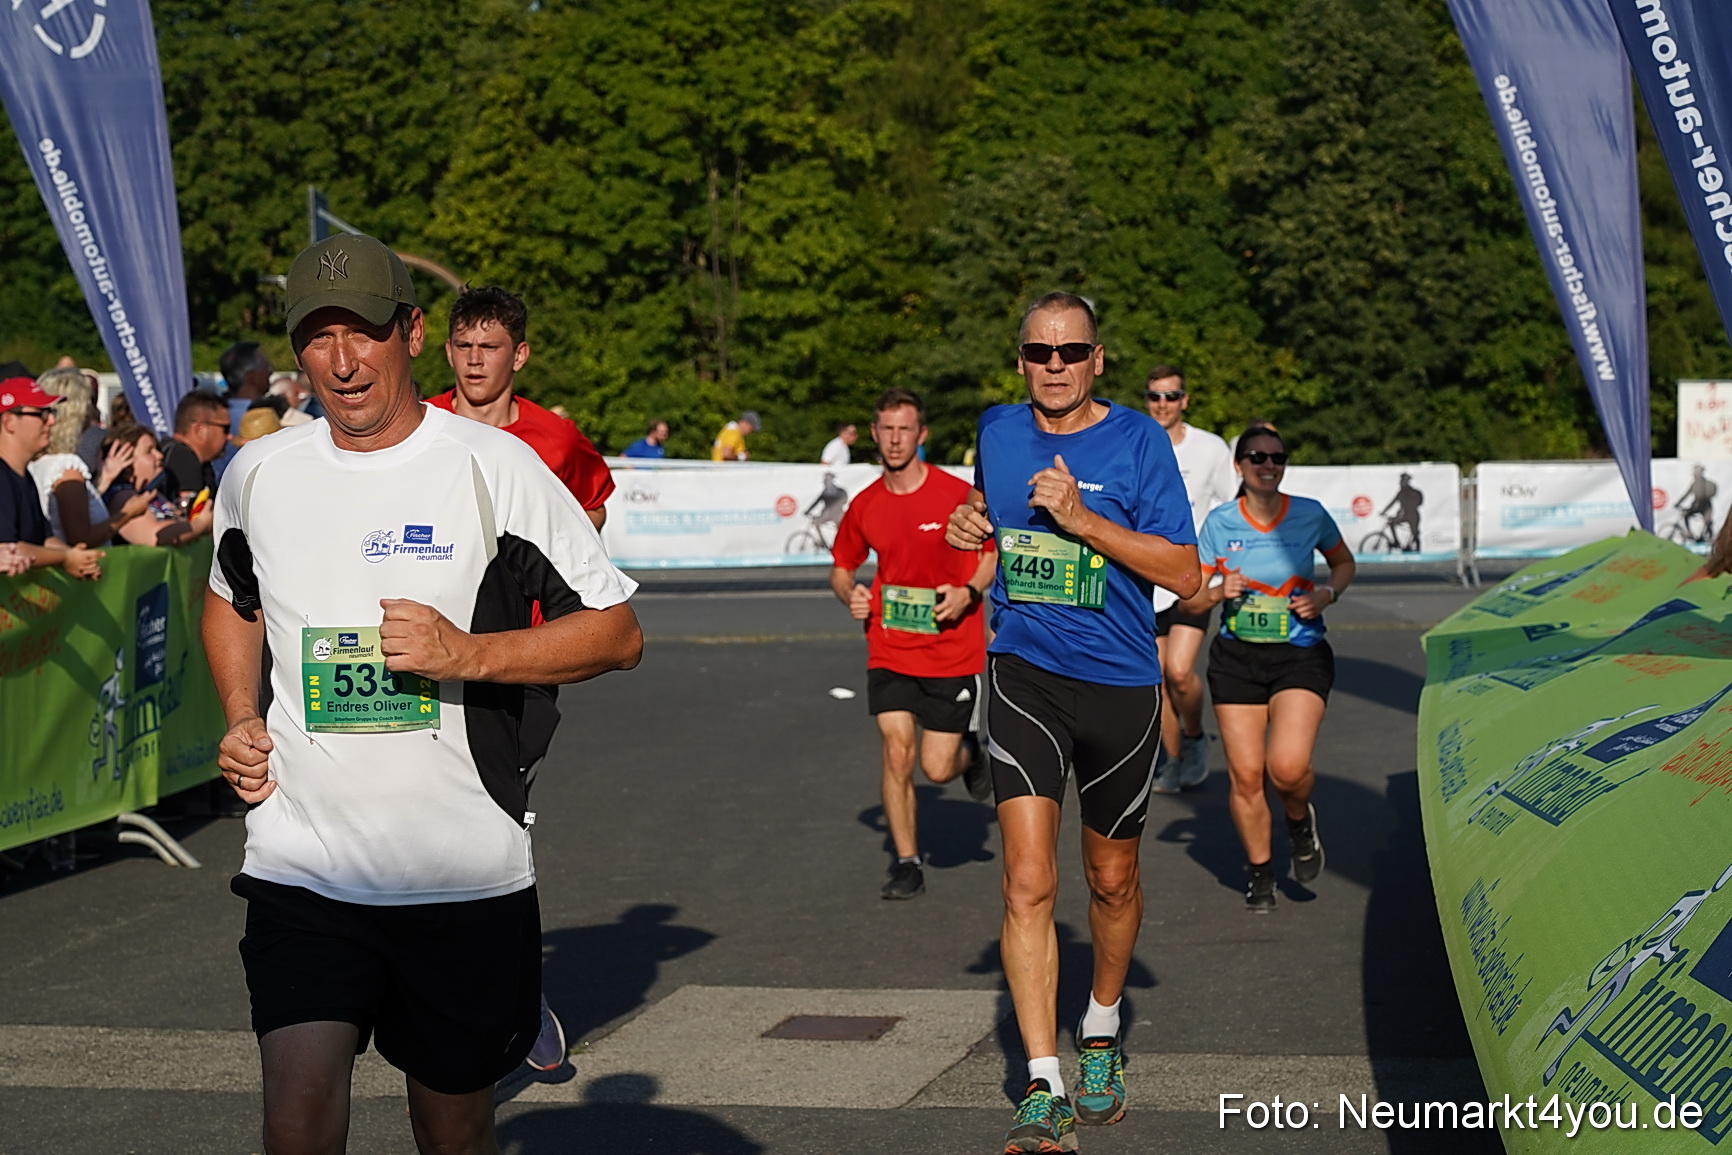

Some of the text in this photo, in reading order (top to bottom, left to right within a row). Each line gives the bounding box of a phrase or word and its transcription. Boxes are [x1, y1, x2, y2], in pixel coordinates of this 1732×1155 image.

[1078, 481, 1104, 492] Berger
[393, 543, 454, 554] Firmenlauf
[416, 553, 453, 561] neumarkt
[1010, 554, 1055, 580] 449
[1004, 578, 1065, 591] ebhardt Simon
[1064, 563, 1075, 596] 2022
[893, 601, 931, 619] 1717
[1248, 612, 1269, 627] 16
[333, 645, 375, 655] Firmenlauf
[333, 663, 403, 697] 535
[309, 675, 321, 711] RUN
[420, 679, 432, 713] 202
[327, 699, 413, 712] Endres Oliver
